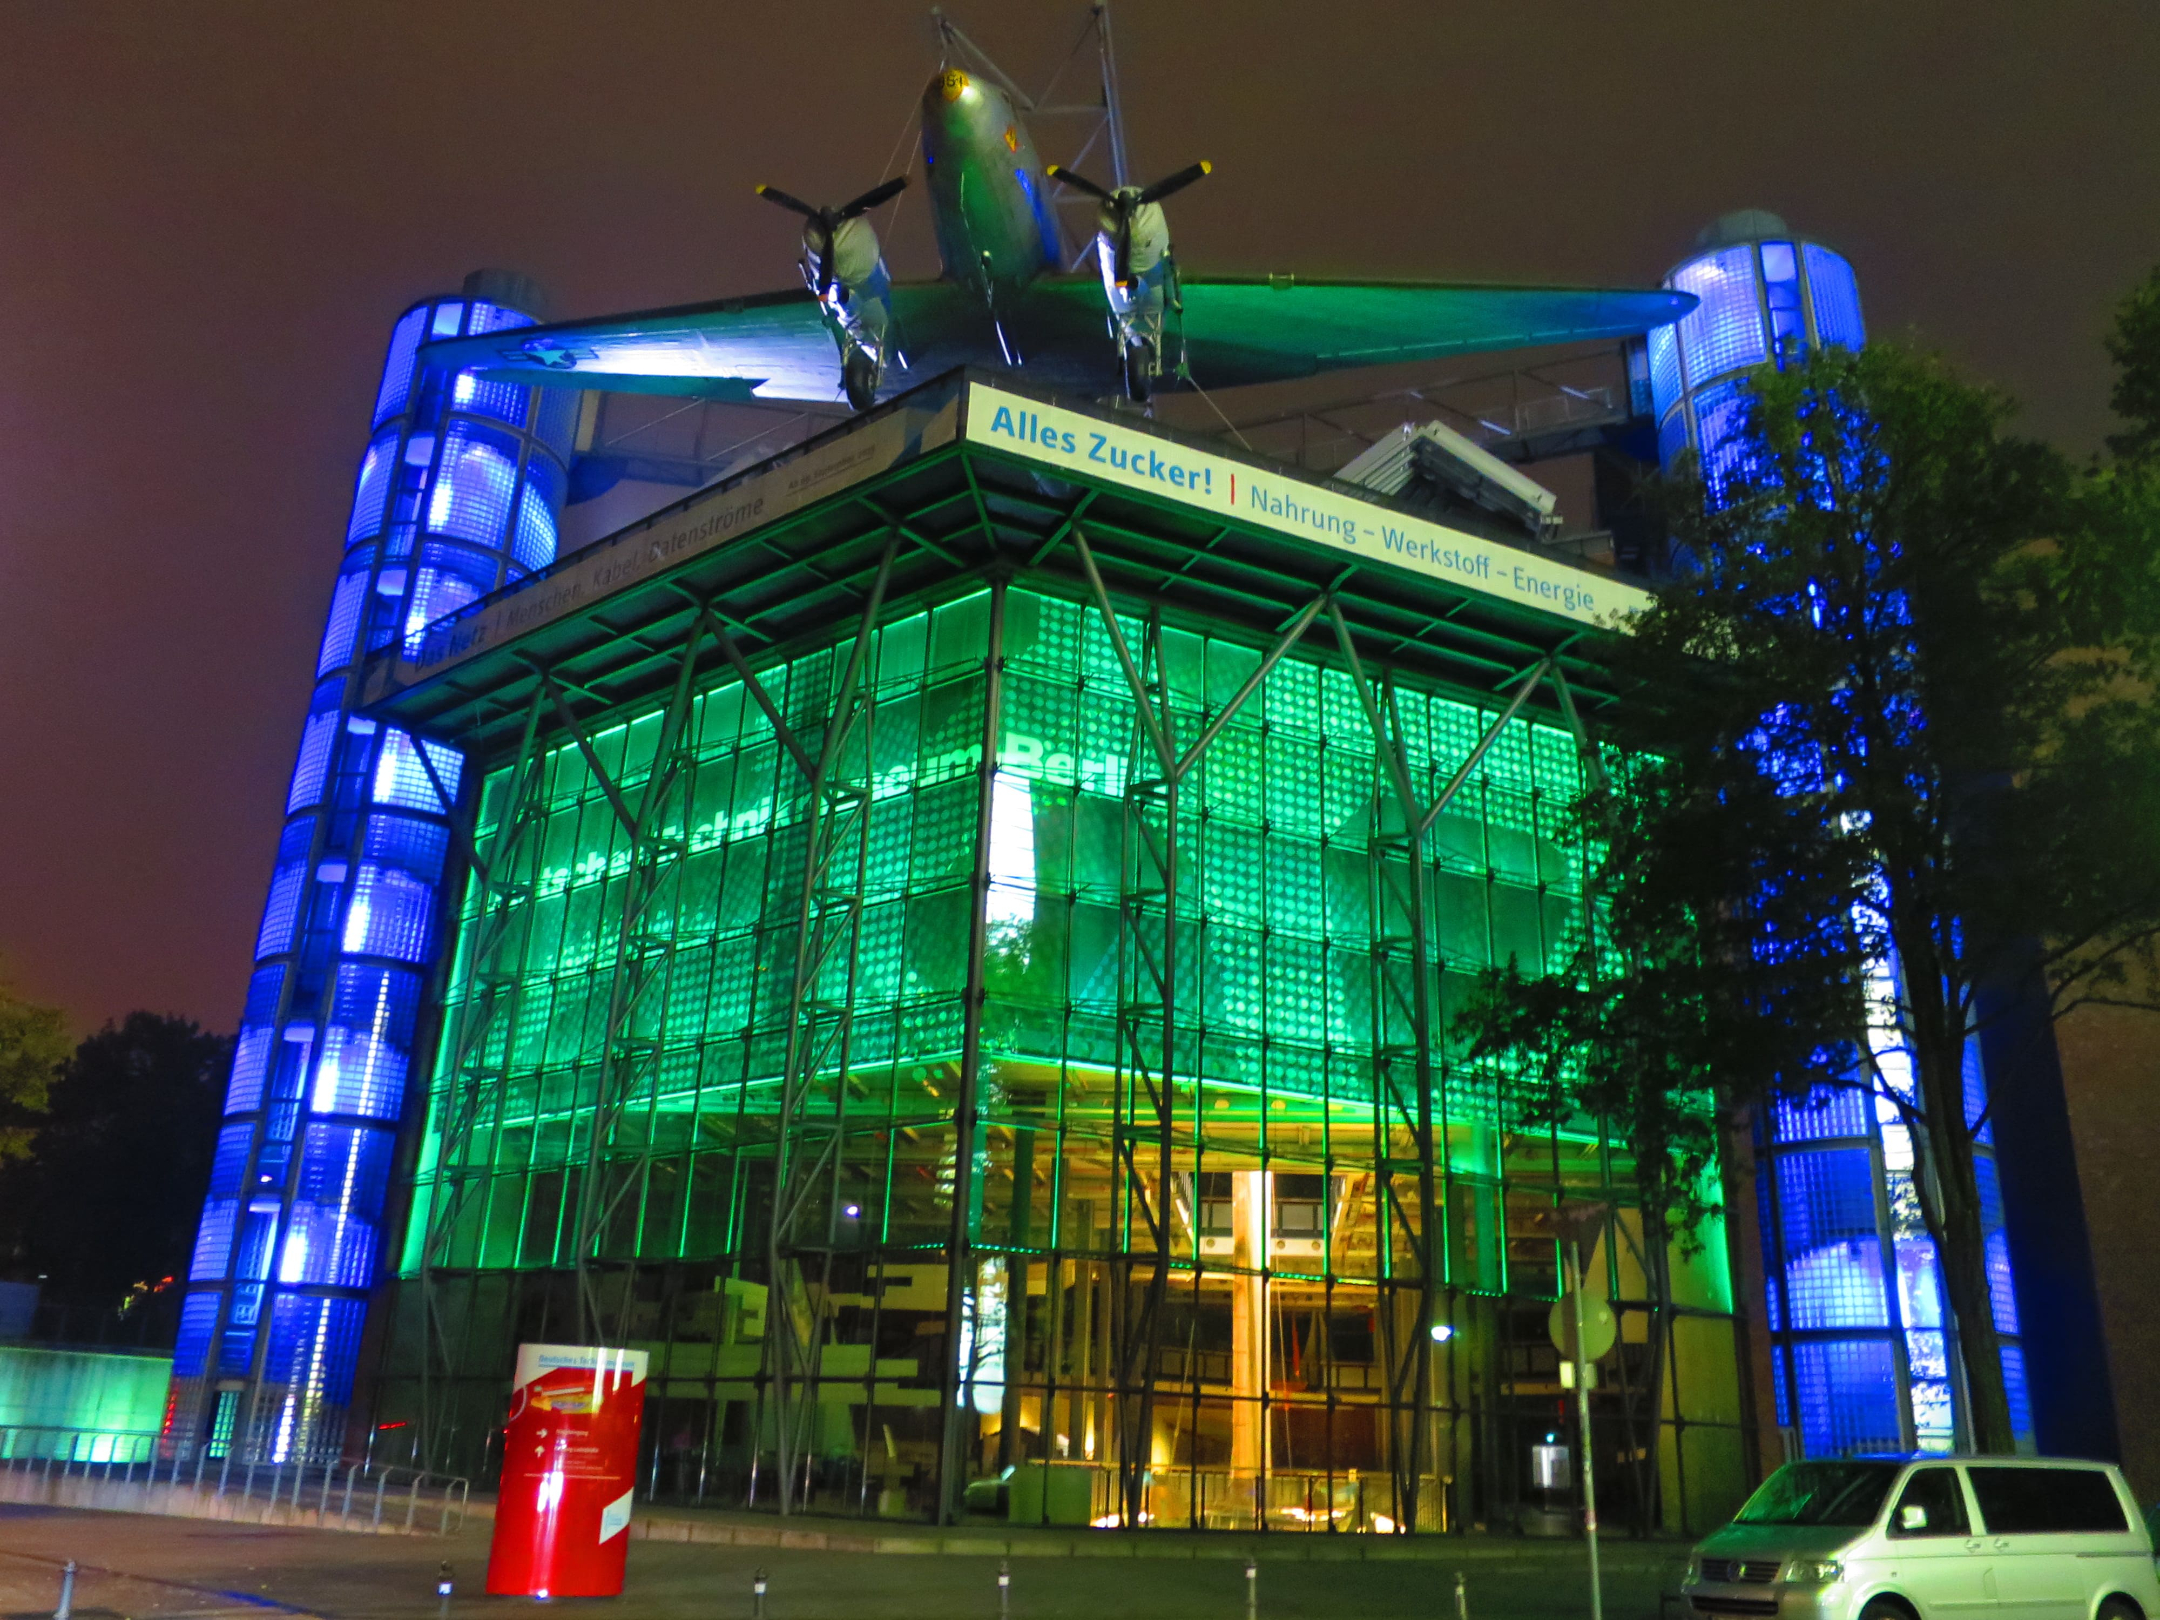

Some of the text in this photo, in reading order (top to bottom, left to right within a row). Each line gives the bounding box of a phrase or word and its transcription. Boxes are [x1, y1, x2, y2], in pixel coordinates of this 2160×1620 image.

[649, 497, 764, 561] Datenströme
[990, 405, 1076, 455] Alles
[1088, 432, 1212, 495] Zucker!
[1250, 484, 1358, 545] Nahrung
[1381, 525, 1491, 580] Werkstoff
[1513, 565, 1595, 612] Energie
